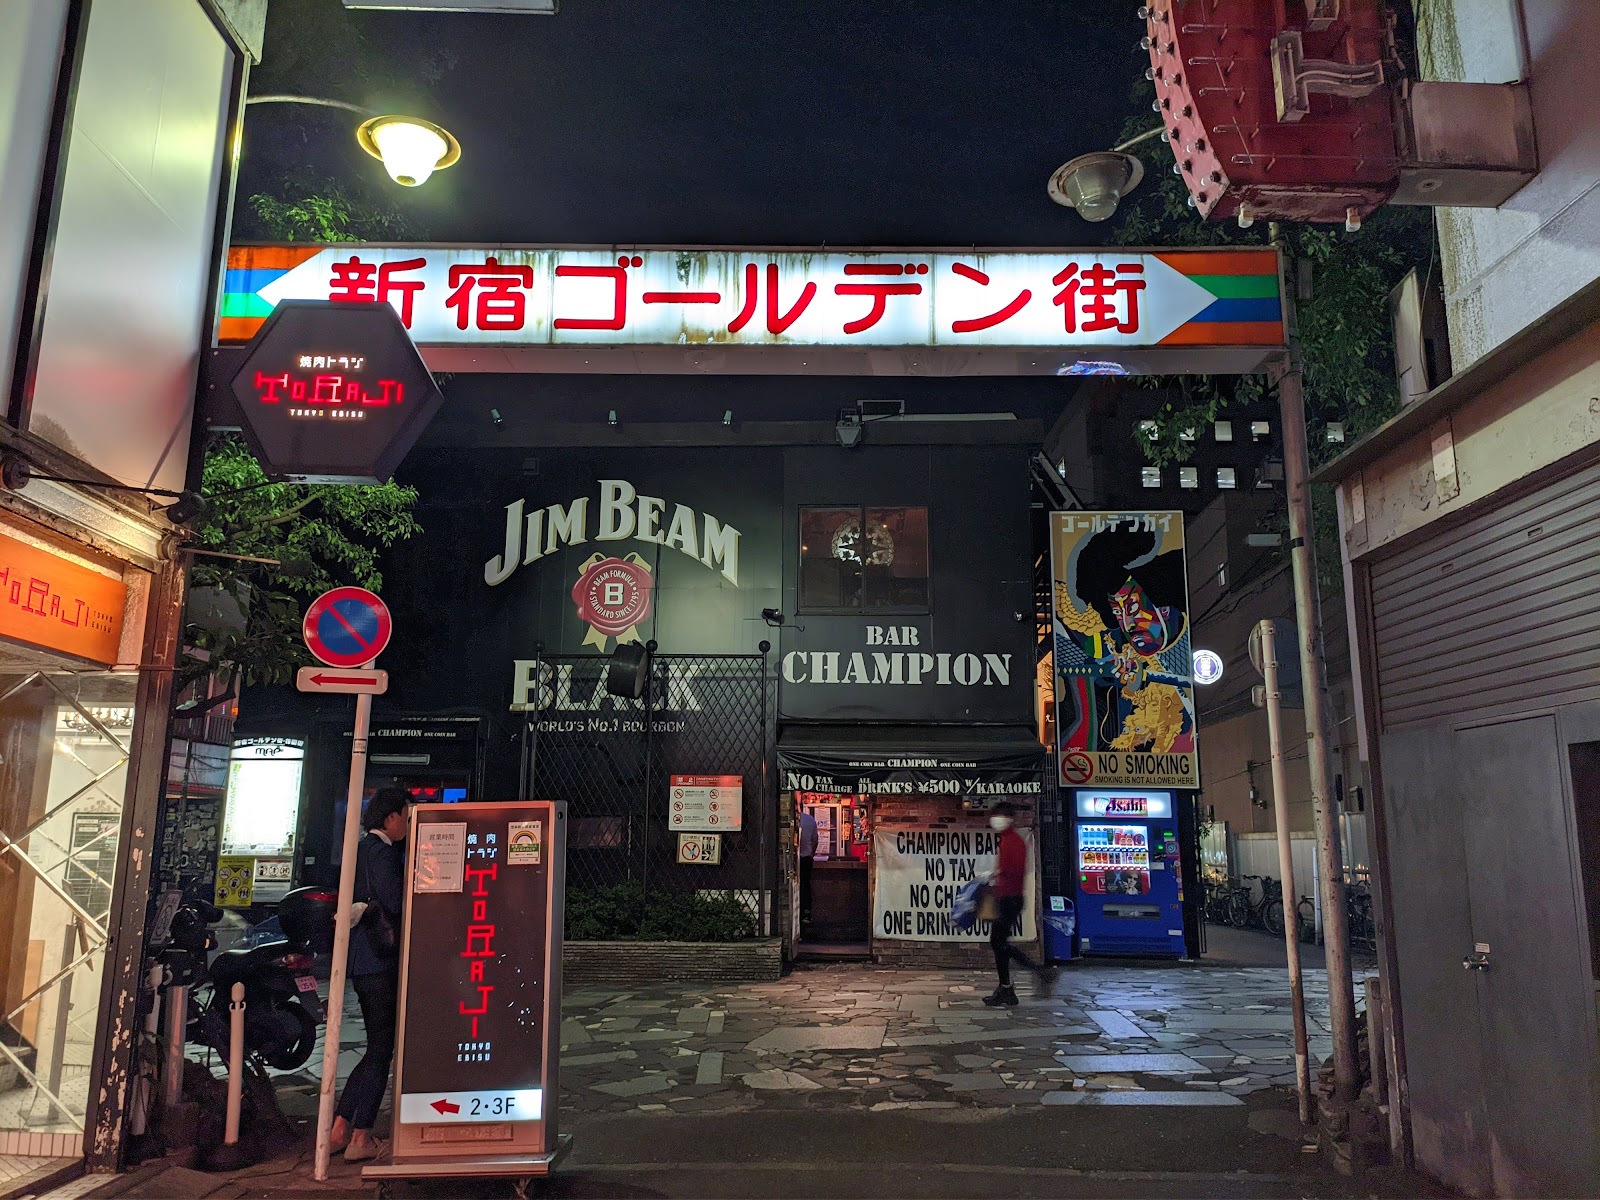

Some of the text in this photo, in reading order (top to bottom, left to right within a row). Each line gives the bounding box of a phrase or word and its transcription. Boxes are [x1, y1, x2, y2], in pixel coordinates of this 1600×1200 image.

[329, 255, 1146, 335] 新宿ゴールデン街
[300, 356, 364, 369] 焼肉トラジ
[255, 372, 404, 406] TORAJI
[332, 410, 364, 418] EBISU
[1062, 514, 1172, 533] ゴールデンガイ
[484, 479, 742, 588] JIM BEAM
[593, 570, 636, 587] BEAM FORMULA
[604, 583, 624, 605] B
[589, 596, 614, 619] STANDARD
[615, 605, 633, 618] SINCE
[629, 591, 639, 608] 1795
[93, 610, 113, 623] TOKYO
[866, 625, 920, 646] BAR
[782, 651, 1012, 686] CHAMPION
[378, 729, 422, 737] CHAMPION
[887, 759, 938, 768] CHAMPION
[1098, 754, 1189, 775] NO SMOKING
[787, 773, 834, 790] NO TAX
[815, 784, 852, 793] CHARGE
[858, 782, 912, 794] DRINK'S
[918, 779, 960, 794] ¥500
[1094, 776, 1194, 785] SMOKING IS NOT ALLOWED HERE
[896, 831, 970, 855] CHAMPION
[467, 848, 498, 859] トラジ
[925, 858, 976, 882] NO TAX
[910, 884, 929, 908] NO
[883, 911, 912, 935] ONE
[458, 1042, 491, 1051] TOKYO
[458, 1053, 491, 1061] EBISU
